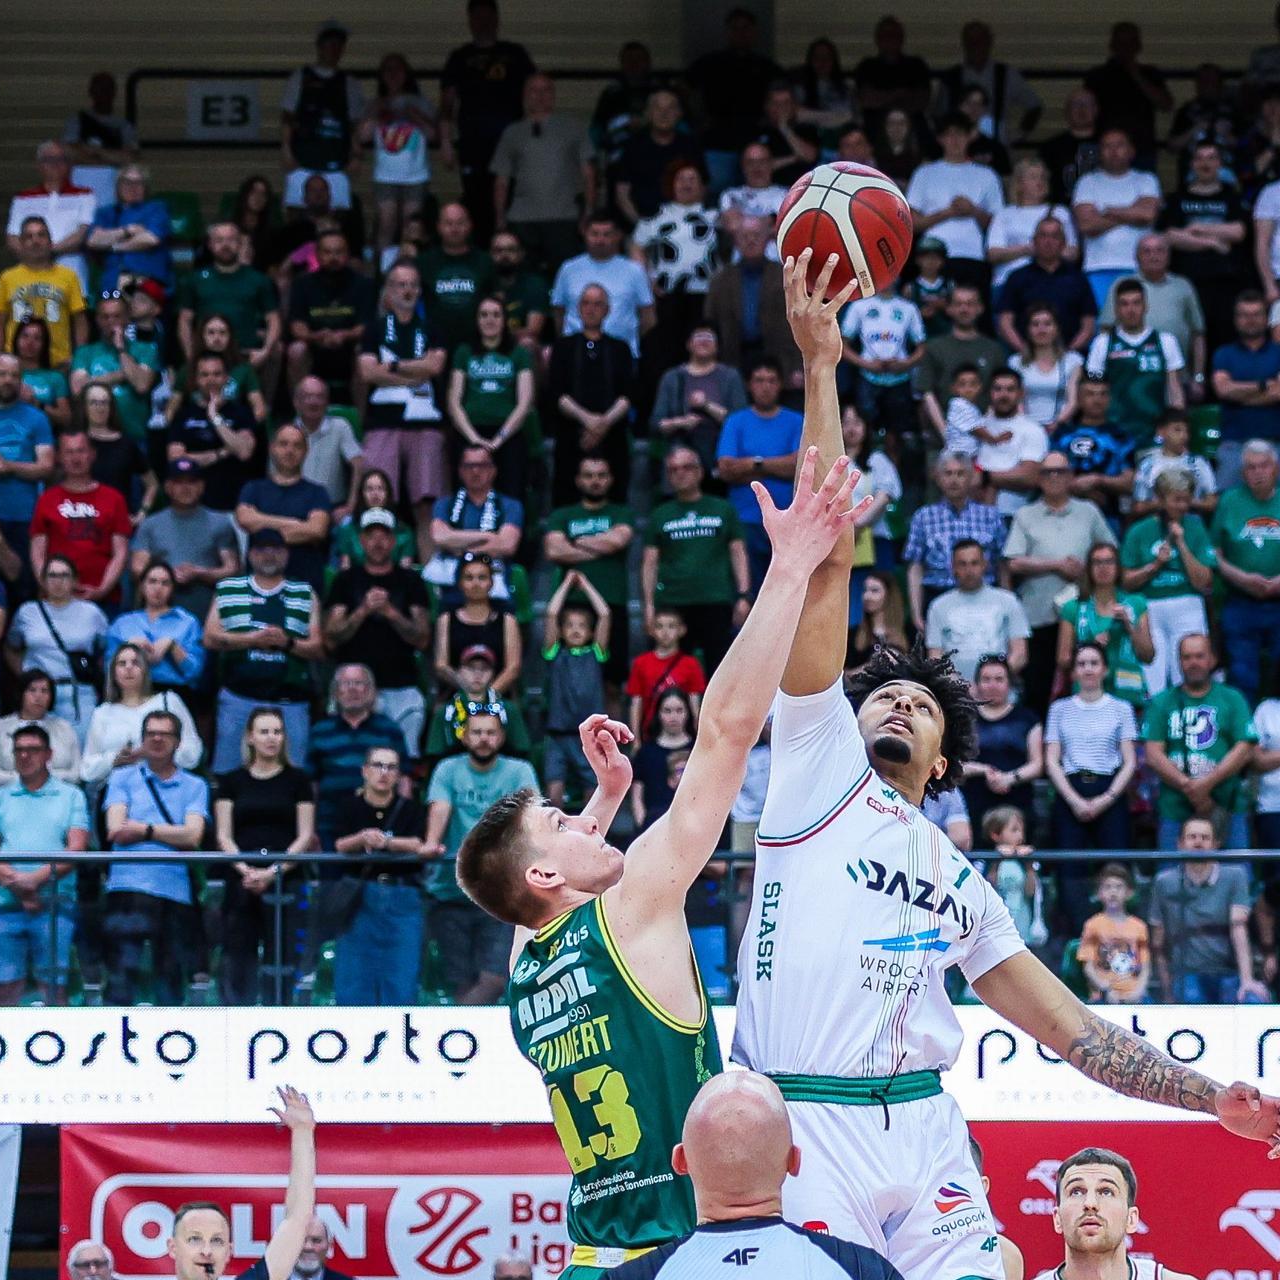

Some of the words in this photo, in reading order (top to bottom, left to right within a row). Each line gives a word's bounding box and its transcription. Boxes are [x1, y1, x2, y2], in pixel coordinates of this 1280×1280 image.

[200, 95, 251, 128] E3
[248, 1013, 480, 1081] posto
[547, 1064, 642, 1175] 13
[931, 1211, 988, 1236] aquapark
[723, 1247, 760, 1266] 4F
[979, 1236, 998, 1252] 4F
